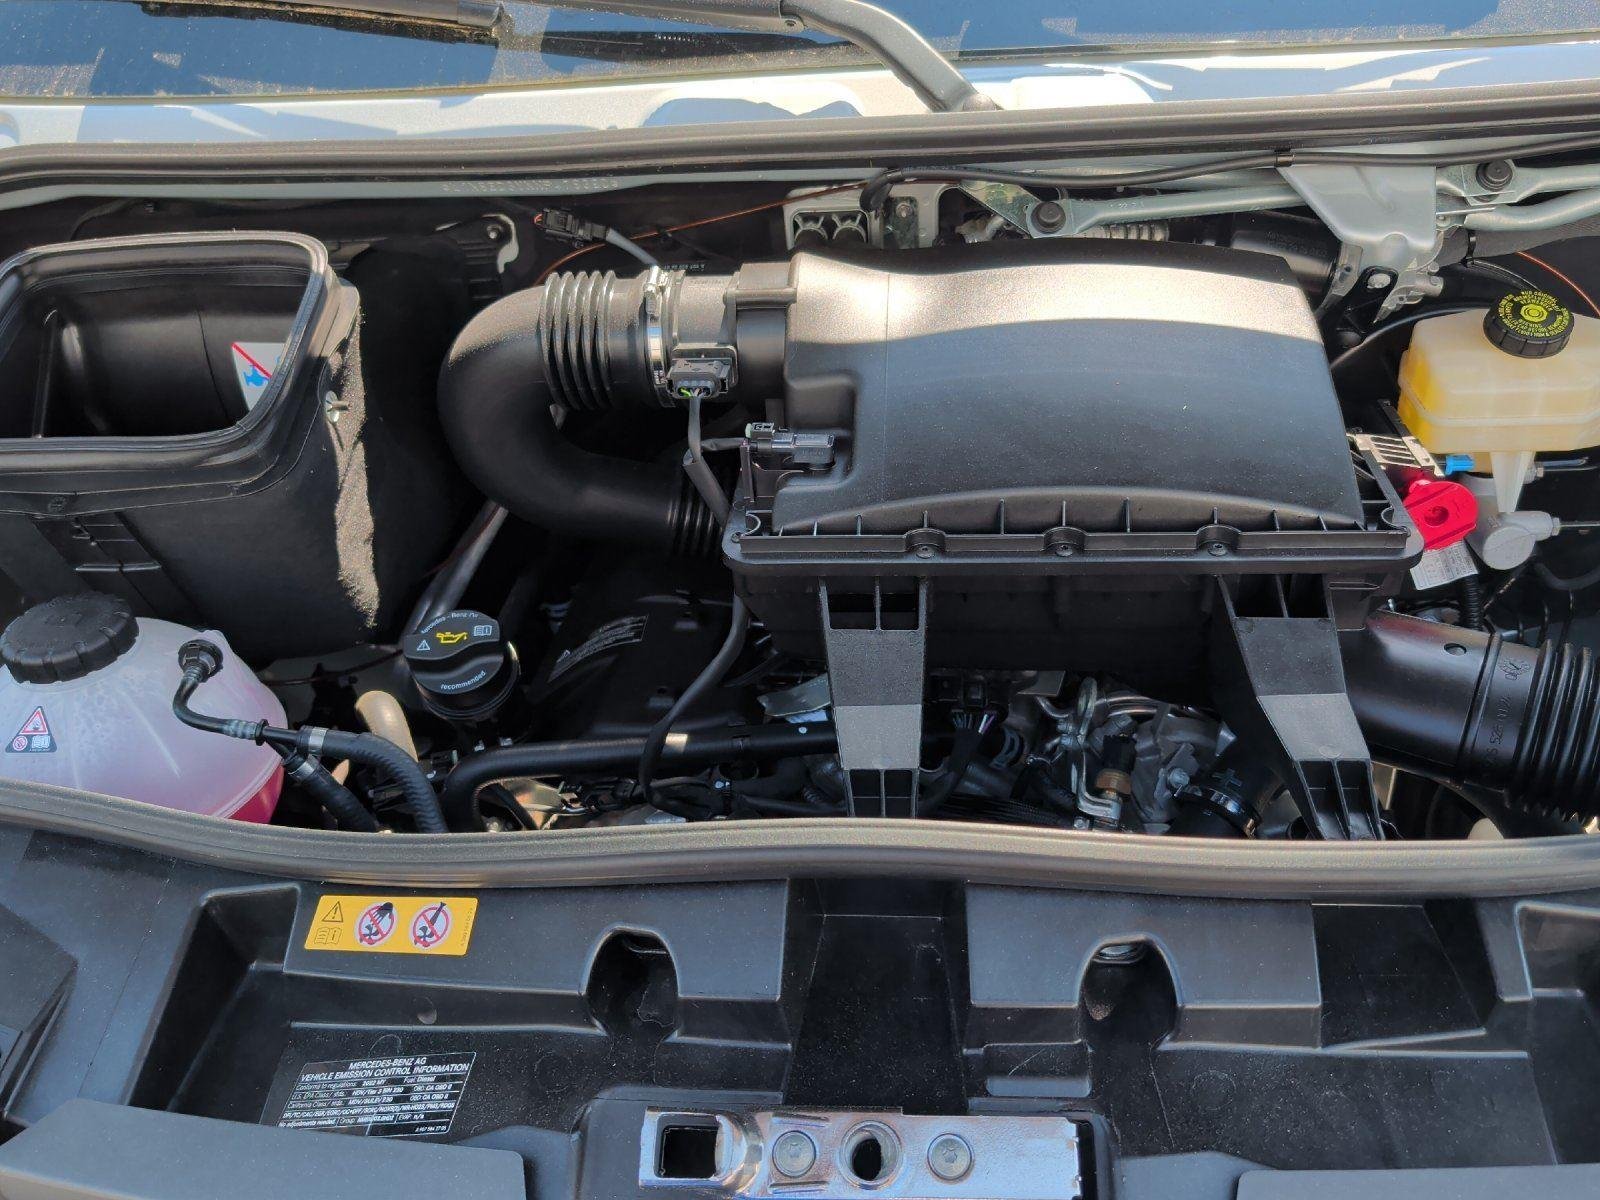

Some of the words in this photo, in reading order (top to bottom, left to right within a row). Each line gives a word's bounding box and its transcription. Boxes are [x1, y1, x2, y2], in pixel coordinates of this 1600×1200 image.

[441, 670, 486, 690] recommended
[301, 1072, 334, 1082] VEHICLE
[334, 1069, 373, 1080] EMISSION
[374, 1067, 411, 1077] CONTROL
[413, 1063, 470, 1074] INFORMATION
[348, 1058, 414, 1070] MERCEDES-BENZ
[415, 1057, 427, 1065] AG
